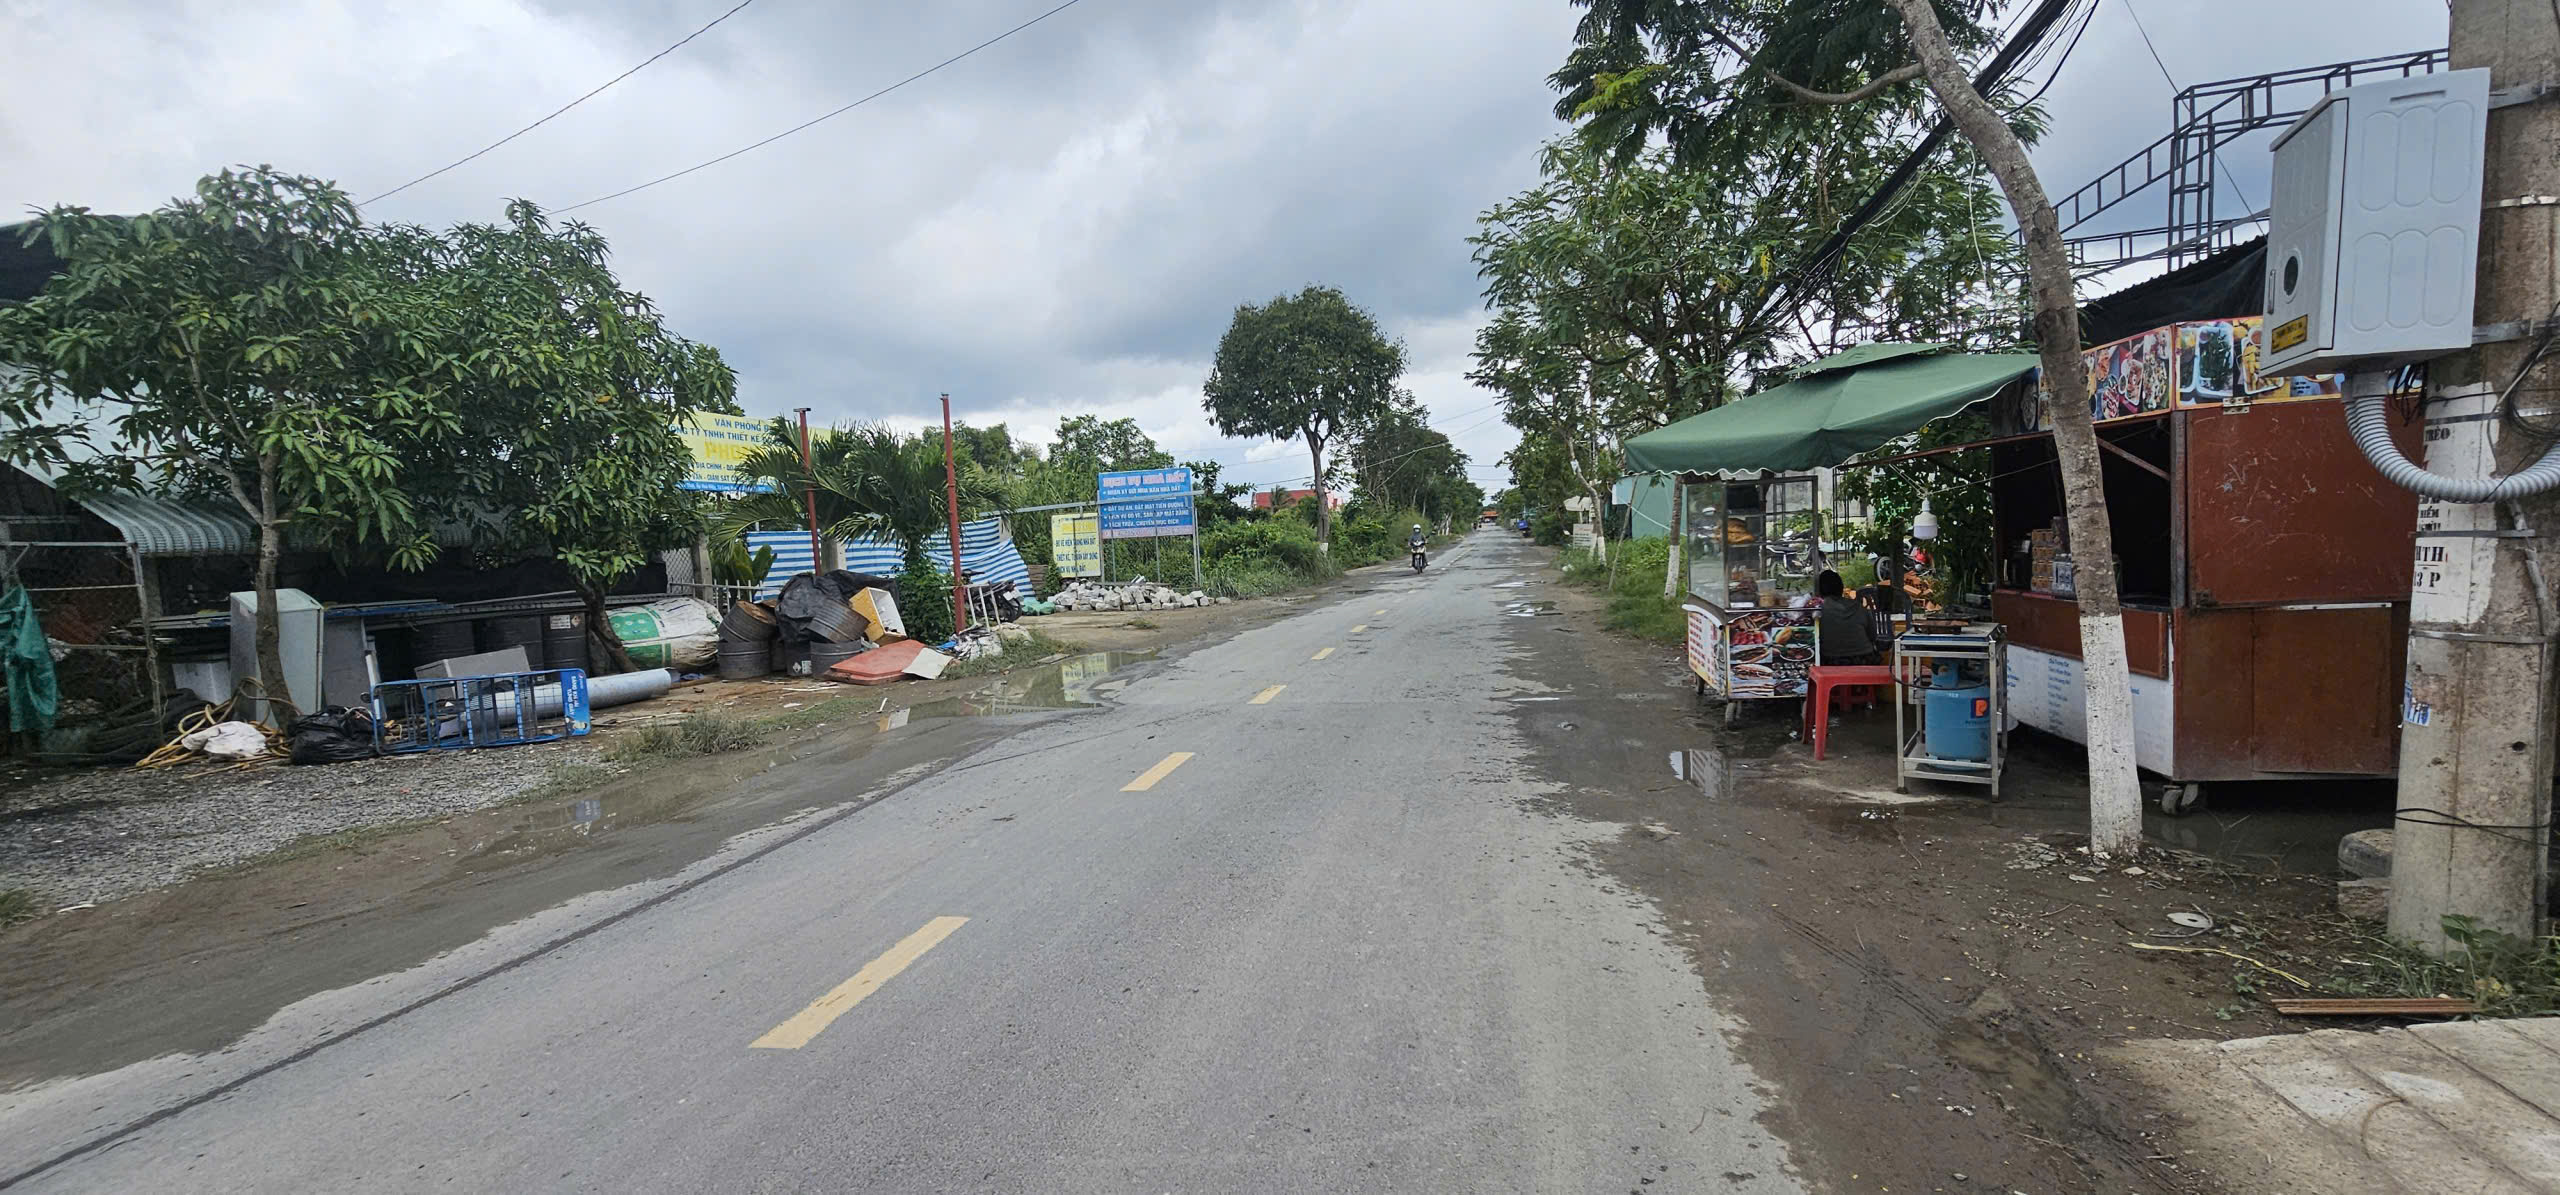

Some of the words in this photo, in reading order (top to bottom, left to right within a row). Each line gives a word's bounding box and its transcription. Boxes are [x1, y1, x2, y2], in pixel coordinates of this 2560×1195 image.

[703, 429, 725, 438] TNHH
[1127, 475, 1142, 487] VỤ
[1165, 470, 1187, 483] ĐẤT
